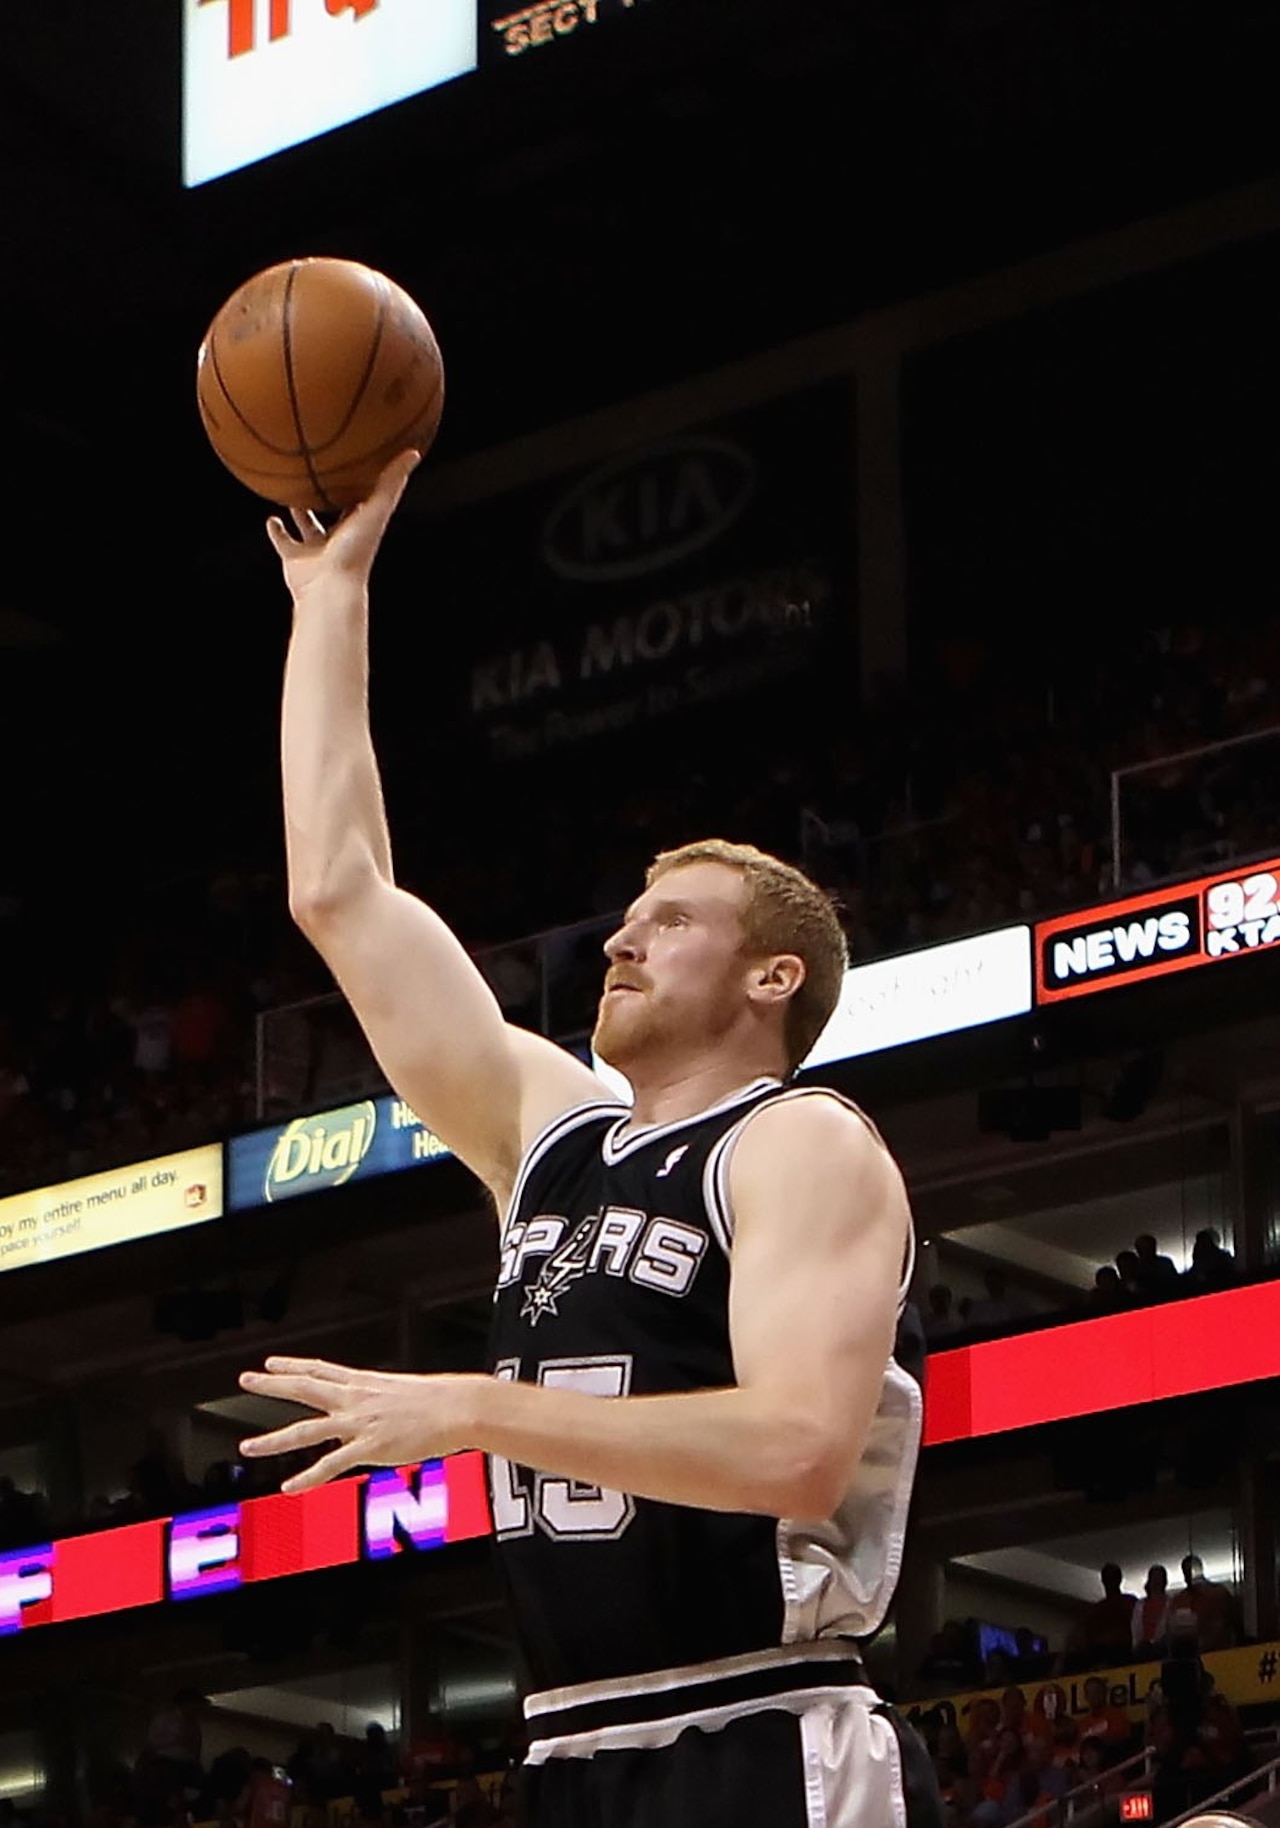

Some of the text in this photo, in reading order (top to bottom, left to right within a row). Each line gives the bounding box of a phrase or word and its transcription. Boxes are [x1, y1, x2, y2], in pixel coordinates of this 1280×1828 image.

[581, 458, 724, 559] KIA
[472, 640, 561, 712] KIA
[1053, 911, 1190, 979] NEWS
[273, 1116, 367, 1183] Dial
[19, 1216, 39, 1235] my
[44, 1199, 83, 1224] entire
[87, 1184, 127, 1209] menu
[131, 1175, 147, 1194] all
